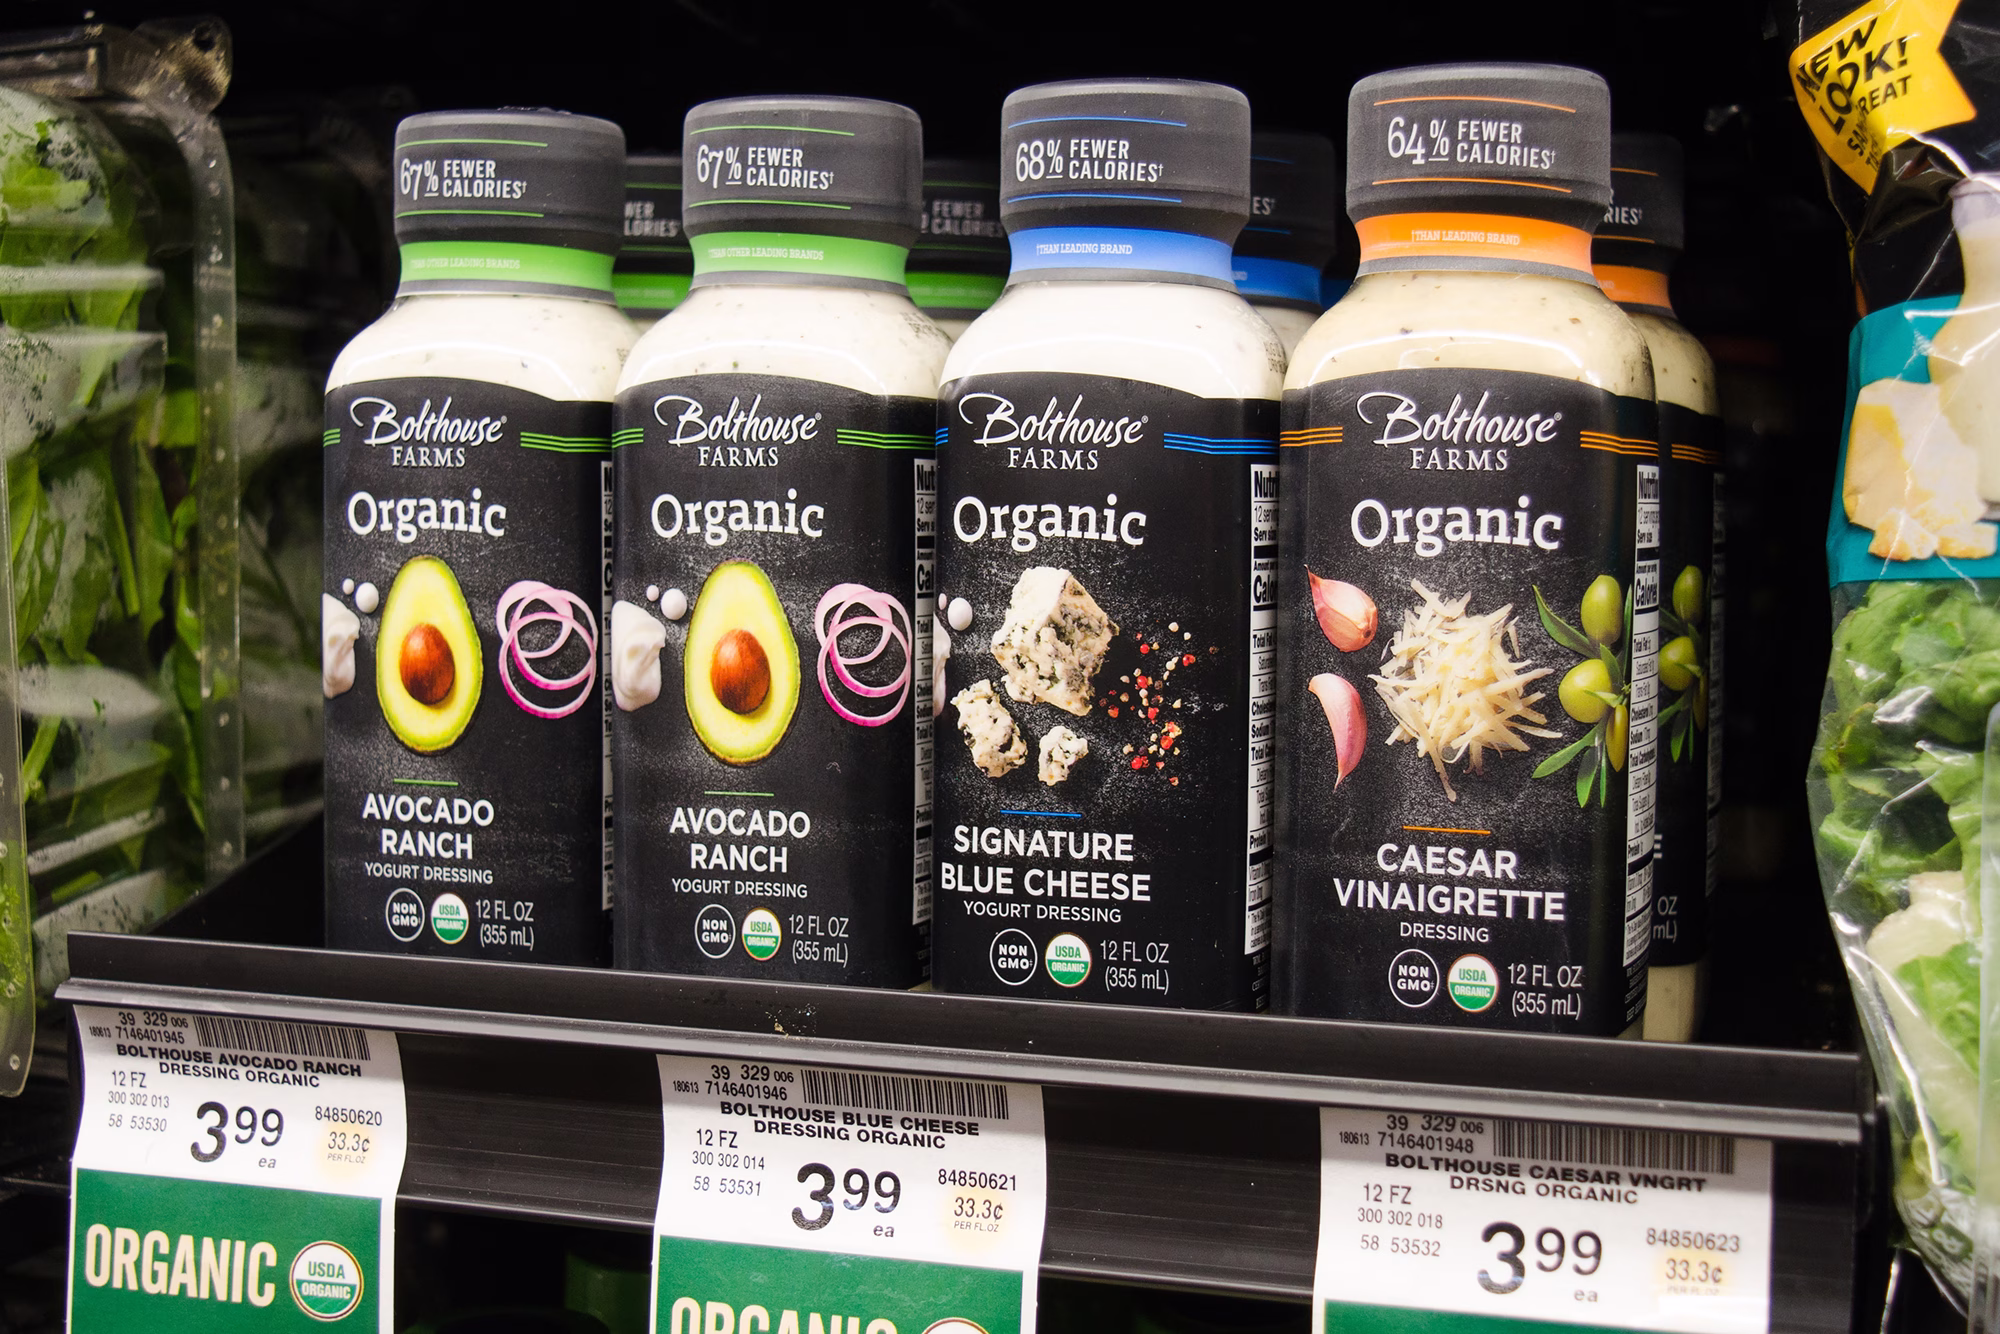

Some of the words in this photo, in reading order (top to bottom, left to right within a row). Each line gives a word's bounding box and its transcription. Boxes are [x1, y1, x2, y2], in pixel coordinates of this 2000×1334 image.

[1795, 17, 1878, 103] NEW
[1819, 35, 1908, 136] LOOK!
[1387, 116, 1449, 166] 64%
[1457, 119, 1522, 144] FEWER
[748, 147, 804, 168] FEWER
[1015, 139, 1063, 182] 68%
[1070, 139, 1130, 160] FEWER
[444, 160, 496, 178] FEWER
[696, 144, 742, 188] 67%
[401, 158, 439, 200] 67%
[1060, 243, 1099, 254] LEADING
[1099, 244, 1133, 255] BRAND
[1442, 230, 1485, 243] LEADING
[1486, 233, 1520, 246] BRAND
[752, 247, 788, 258] LEADING
[789, 248, 824, 260] BRANDS
[391, 446, 466, 468] FARMS
[698, 446, 779, 467] FARMS
[1007, 447, 1099, 471] FARMS
[1410, 447, 1508, 471] FARMS
[347, 487, 506, 543] Organic
[651, 488, 824, 547] Organic
[953, 493, 1146, 552] Organic
[1351, 495, 1562, 558] Organic
[362, 793, 495, 827] AVOCADO
[669, 806, 810, 839] AVOCADO
[381, 828, 473, 860] RANCH
[954, 825, 1134, 861] SIGNATURE
[690, 843, 788, 873] RANCH
[1376, 842, 1517, 880] CAESAR
[365, 862, 420, 879] YOGURT
[424, 865, 493, 885] DRESSING
[941, 862, 1014, 895] BLUE
[1024, 869, 1151, 902] CHEESE
[671, 878, 731, 895] YOGURT
[735, 880, 808, 899] DRESSING
[1333, 878, 1565, 921] VINAIGRETTE
[392, 901, 417, 914] NON
[438, 904, 461, 917] USDA
[476, 899, 490, 919] 12
[494, 901, 511, 921] FL
[514, 902, 534, 922] OZ
[963, 900, 1031, 918] YOGURT
[1036, 905, 1122, 923] DRESSING
[1657, 896, 1678, 916] OZ
[702, 919, 727, 931] NON
[750, 920, 773, 933] USDA
[789, 914, 803, 934] 12
[808, 916, 825, 935] FL
[828, 917, 849, 937] OZ
[1400, 921, 1489, 943] DRESSING
[480, 923, 507, 948] (355
[511, 926, 535, 951] mL)
[746, 935, 776, 949] ORGANIC
[792, 939, 820, 964] (355
[823, 942, 848, 968] mL)
[999, 943, 1028, 957] NON
[1055, 945, 1081, 959] USDA
[1100, 940, 1117, 961] 12
[1122, 941, 1142, 962] FL
[1146, 942, 1170, 964] OZ
[1051, 960, 1085, 974] ORGANIC
[1398, 965, 1429, 978] NON
[1458, 968, 1487, 983] USDA
[1507, 963, 1526, 985] 12
[1532, 965, 1553, 987] FL
[1557, 966, 1583, 989] OZ
[1105, 966, 1136, 991] (355
[1141, 969, 1170, 995] mL)
[1454, 984, 1491, 999] ORGANIC
[1511, 992, 1547, 1017] (355
[1551, 997, 1582, 1021] mL)
[119, 1012, 136, 1026] 39
[143, 1011, 168, 1027] 329
[171, 1017, 189, 1028] 006
[115, 1026, 185, 1044] 7146401945
[116, 1043, 213, 1064] BOLTHOUSE
[219, 1053, 298, 1072] AVOCADO
[303, 1060, 362, 1078] RANCH
[112, 1070, 126, 1087] 12
[131, 1072, 147, 1089] FZ
[159, 1062, 240, 1081] DRESSING
[245, 1070, 320, 1088] ORGANIC
[711, 1065, 731, 1081] 39
[740, 1064, 770, 1082] 329
[774, 1070, 794, 1084] 006
[108, 1090, 127, 1105] 300
[129, 1092, 148, 1107] 302
[151, 1094, 170, 1109] 013
[673, 1080, 699, 1094] 180613
[705, 1081, 787, 1101] 7146401946
[108, 1113, 123, 1128] 58
[130, 1115, 167, 1132] 53530
[315, 1106, 383, 1127] 84850620
[720, 1101, 835, 1124] BOLTHOUSE
[842, 1111, 893, 1129] BLUE
[900, 1116, 980, 1137] CHEESE
[1386, 1114, 1409, 1132] 39
[1420, 1114, 1456, 1132] 329
[1460, 1120, 1484, 1134] 006
[696, 1130, 713, 1147] 12
[719, 1131, 738, 1148] FZ
[754, 1120, 850, 1141] DRESSING
[857, 1129, 946, 1150] ORGANIC
[1339, 1131, 1370, 1147] 180613
[1378, 1132, 1474, 1153] 7146401948
[258, 1156, 277, 1169] ea
[692, 1151, 714, 1166] 300
[718, 1153, 739, 1169] 302
[743, 1155, 765, 1171] 014
[938, 1169, 1017, 1191] 84850621
[1385, 1153, 1520, 1178] BOLTHOUSE
[1528, 1164, 1620, 1186] CAESAR
[1628, 1172, 1706, 1192] VNGRT
[693, 1176, 710, 1191] 58
[719, 1178, 762, 1196] 53531
[1363, 1184, 1383, 1203] 12
[1389, 1185, 1412, 1205] FZ
[1450, 1175, 1526, 1196] DRSNG
[1535, 1182, 1639, 1205] ORGANIC
[953, 1220, 972, 1231] PER
[1357, 1208, 1383, 1224] 300
[1387, 1210, 1412, 1227] 302
[1417, 1212, 1443, 1229] 018
[873, 1223, 895, 1239] ea
[1646, 1227, 1740, 1253] 84850623
[1360, 1234, 1380, 1252] 58
[1390, 1237, 1441, 1257] 53532
[85, 1223, 277, 1308] ORGANIC
[307, 1260, 346, 1279] USDA
[301, 1282, 351, 1300] ORGANIC
[1574, 1288, 1599, 1303] ea
